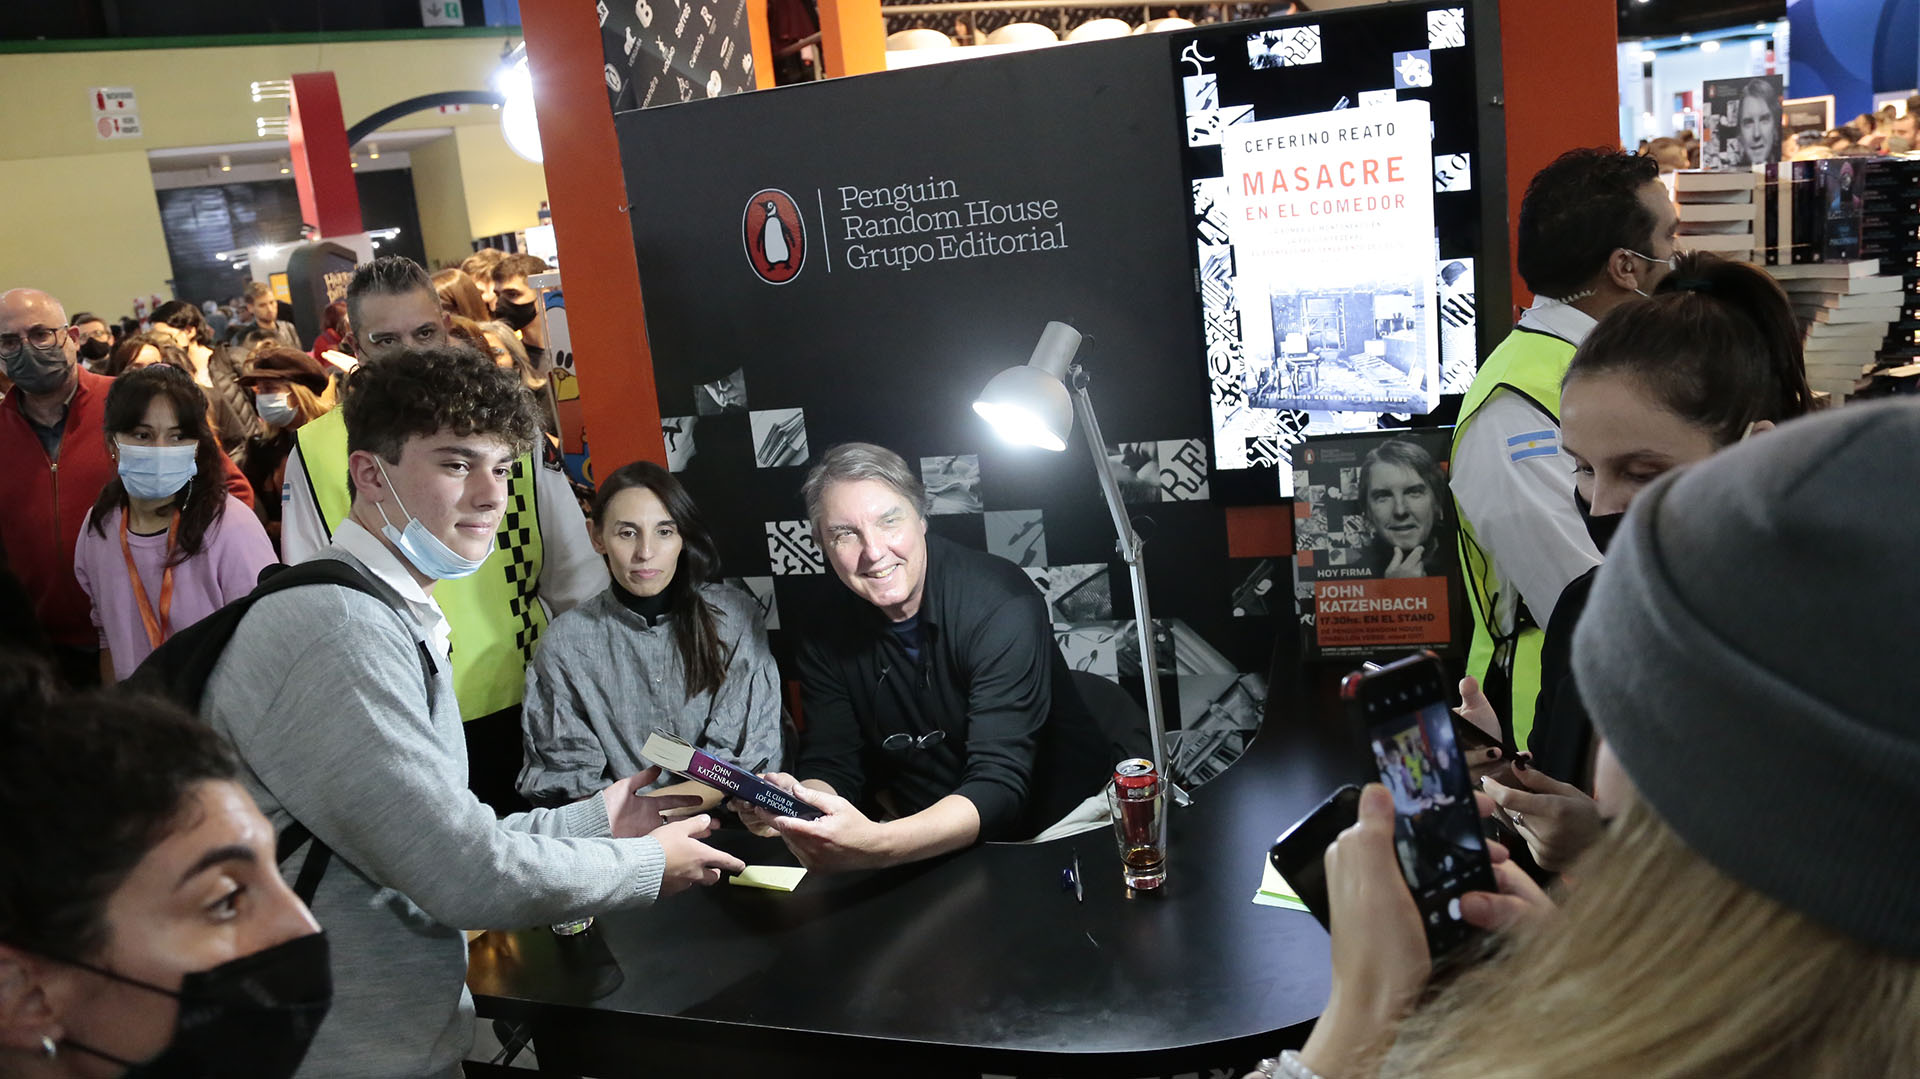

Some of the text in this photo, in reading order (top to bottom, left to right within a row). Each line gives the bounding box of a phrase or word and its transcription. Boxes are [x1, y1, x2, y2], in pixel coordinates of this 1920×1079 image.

[1244, 122, 1396, 153] CEFERINO REATO
[1242, 155, 1405, 197] MASACRE
[837, 175, 960, 212] Penguin
[1245, 193, 1406, 221] EN EL COMEDOR
[841, 198, 1060, 241] Random House
[846, 221, 1070, 272] Grupo Editorial
[1316, 567, 1373, 578] HOY FIRMA
[1318, 584, 1365, 599] JOHN
[1319, 597, 1428, 614] KATZENBACH
[1363, 614, 1381, 624] EN
[1381, 613, 1395, 624] EL
[1397, 612, 1436, 623] STAND
[697, 765, 740, 792] KATZENBACH
[711, 763, 732, 778] JOHN
[755, 792, 766, 803] LOS
[772, 792, 786, 804] CLUB
[785, 800, 794, 808] DE
